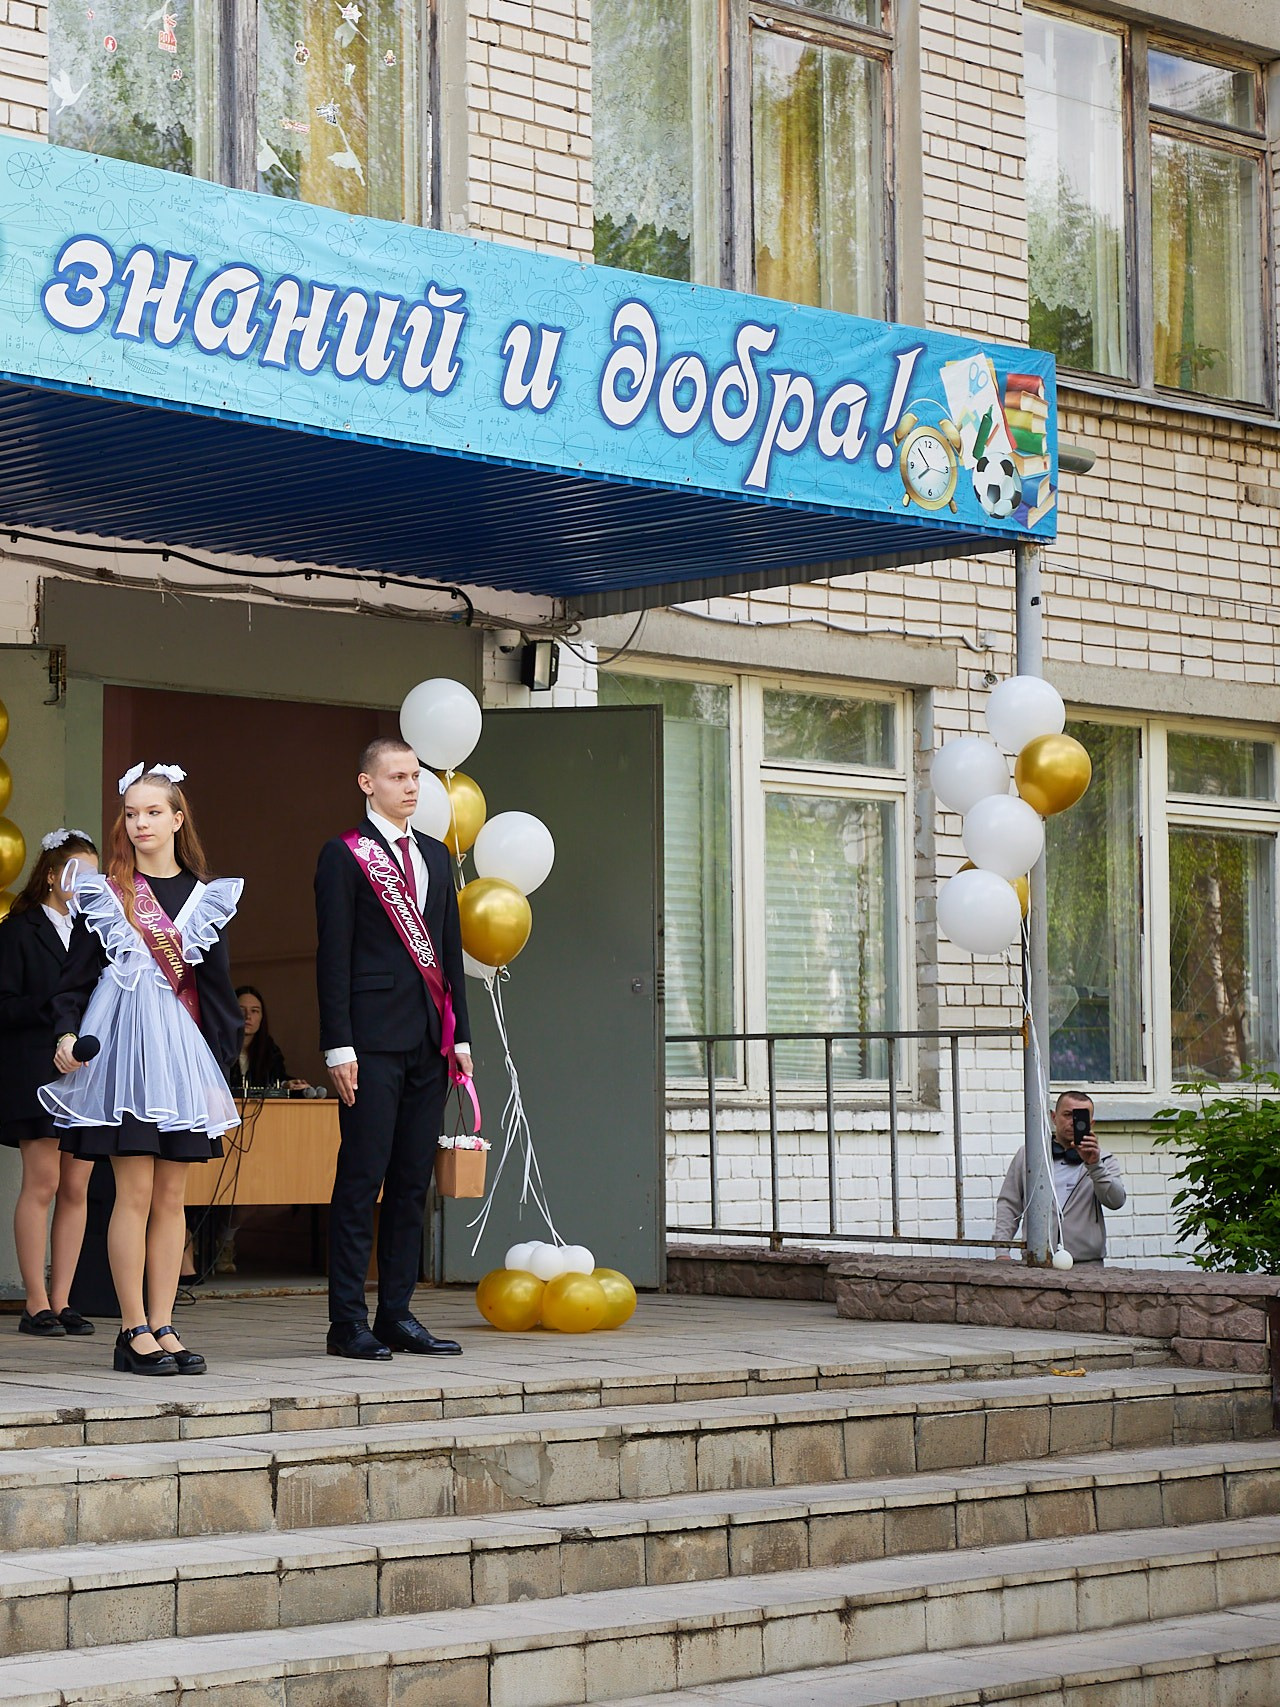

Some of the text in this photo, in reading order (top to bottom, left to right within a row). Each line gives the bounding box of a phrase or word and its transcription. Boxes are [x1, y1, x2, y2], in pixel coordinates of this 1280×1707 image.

[41, 234, 470, 397] знаний
[500, 319, 566, 415] и
[598, 297, 928, 490] добра!
[924, 440, 932, 449] 12
[910, 461, 915, 470] 9
[944, 466, 950, 474] 3
[927, 488, 933, 497] 6
